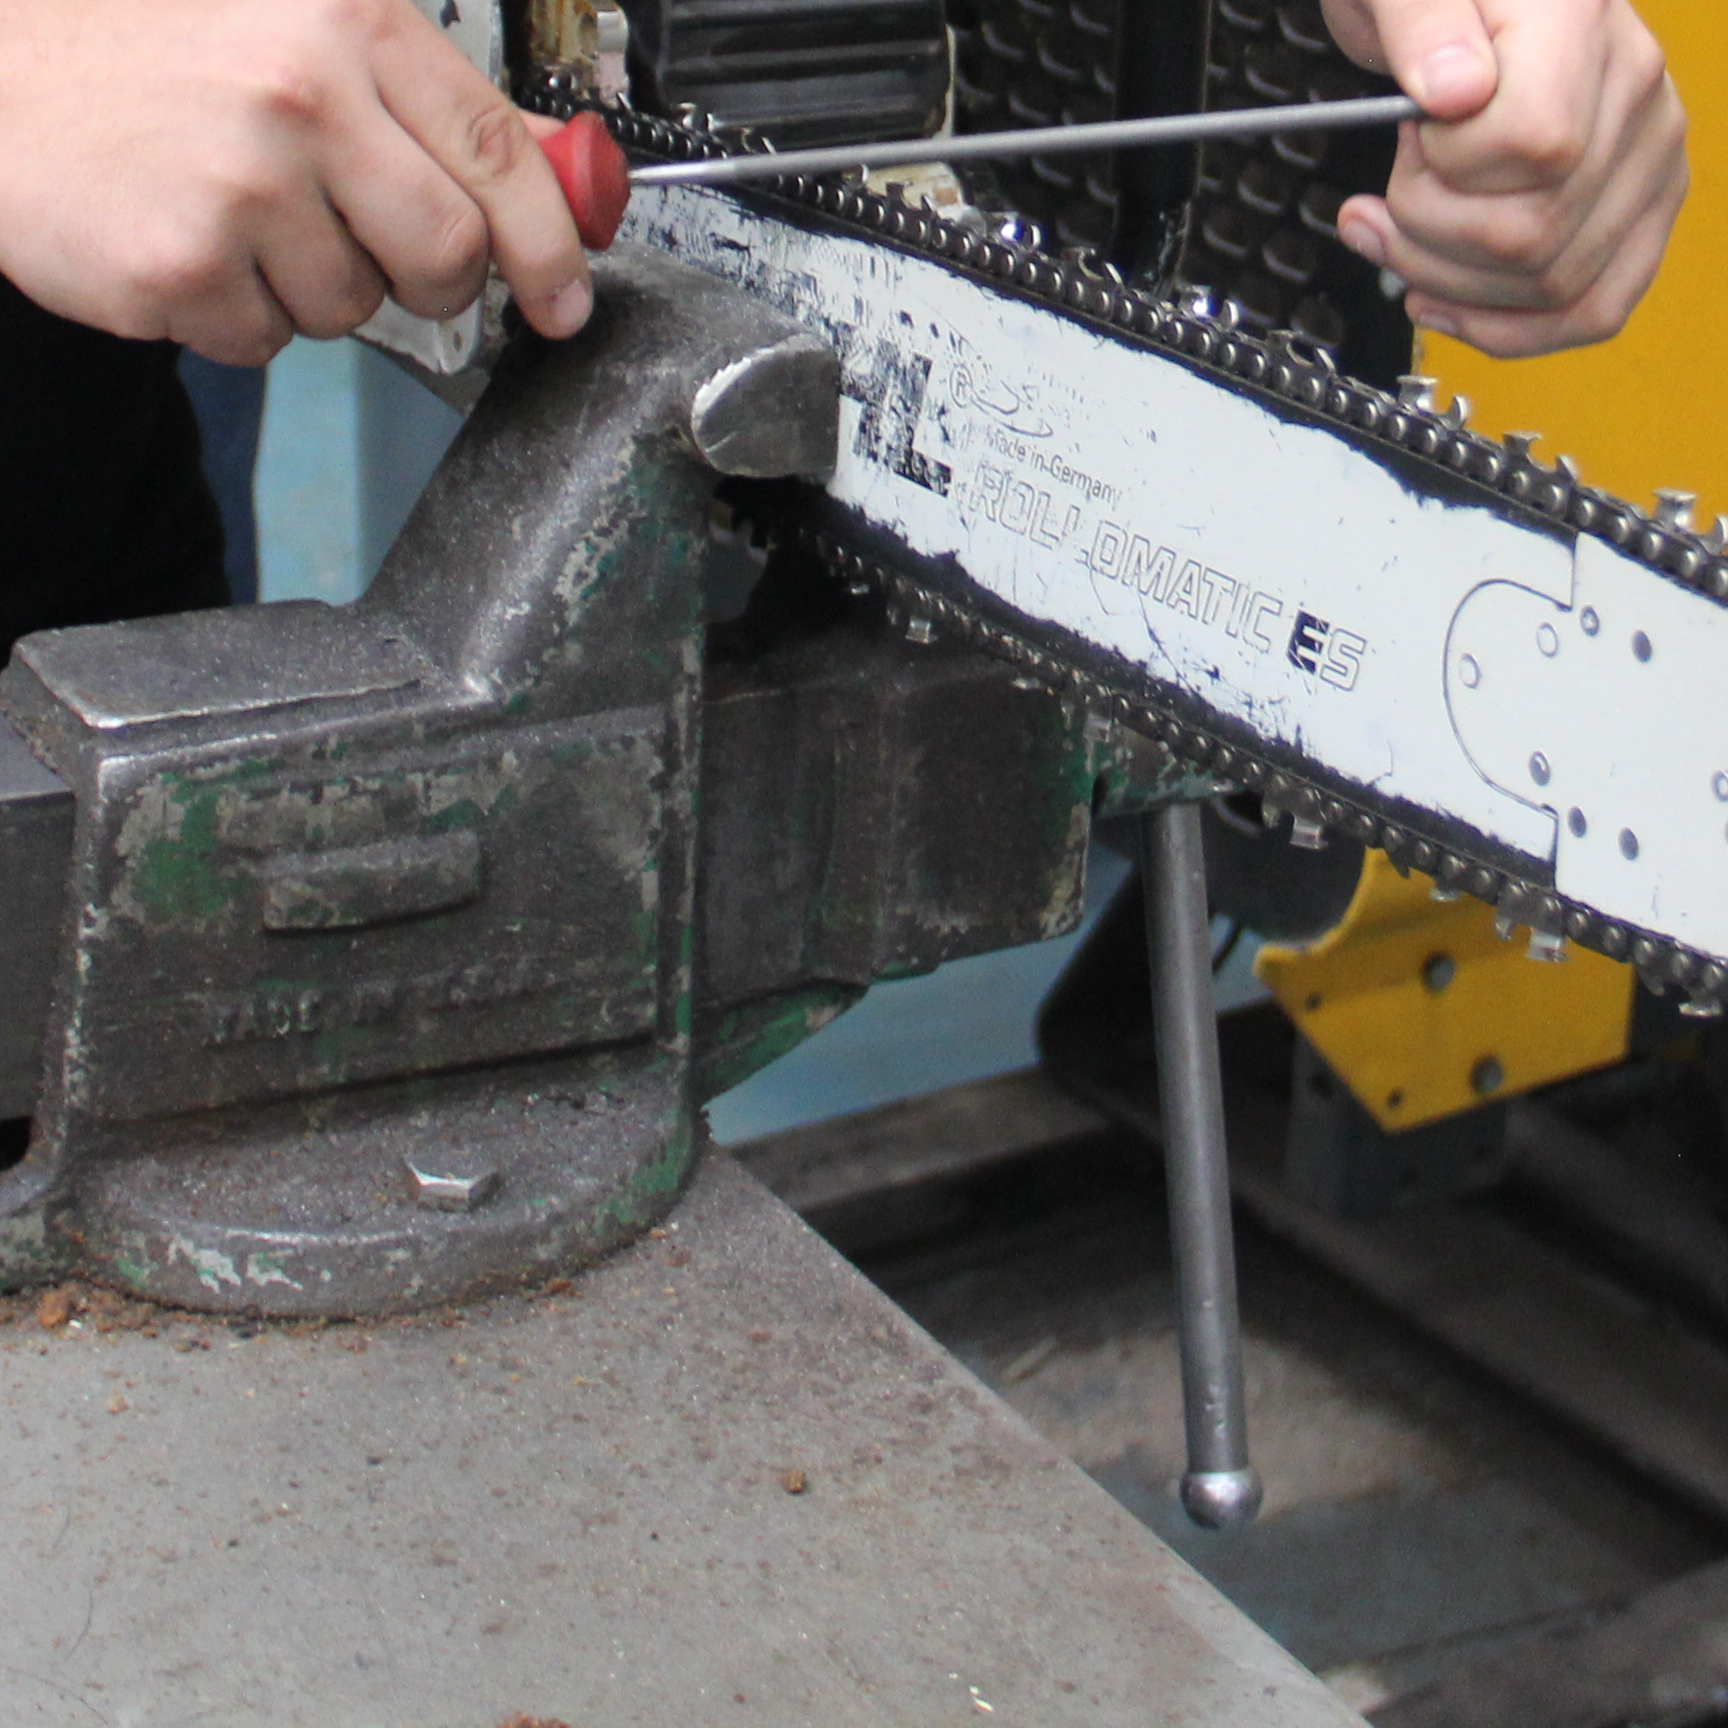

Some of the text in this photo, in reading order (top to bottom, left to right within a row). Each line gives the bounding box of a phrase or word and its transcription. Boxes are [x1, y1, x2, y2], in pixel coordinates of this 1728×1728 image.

[986, 423, 1026, 462] Made
[1050, 454, 1122, 512] Germany
[1285, 608, 1368, 693] ES
